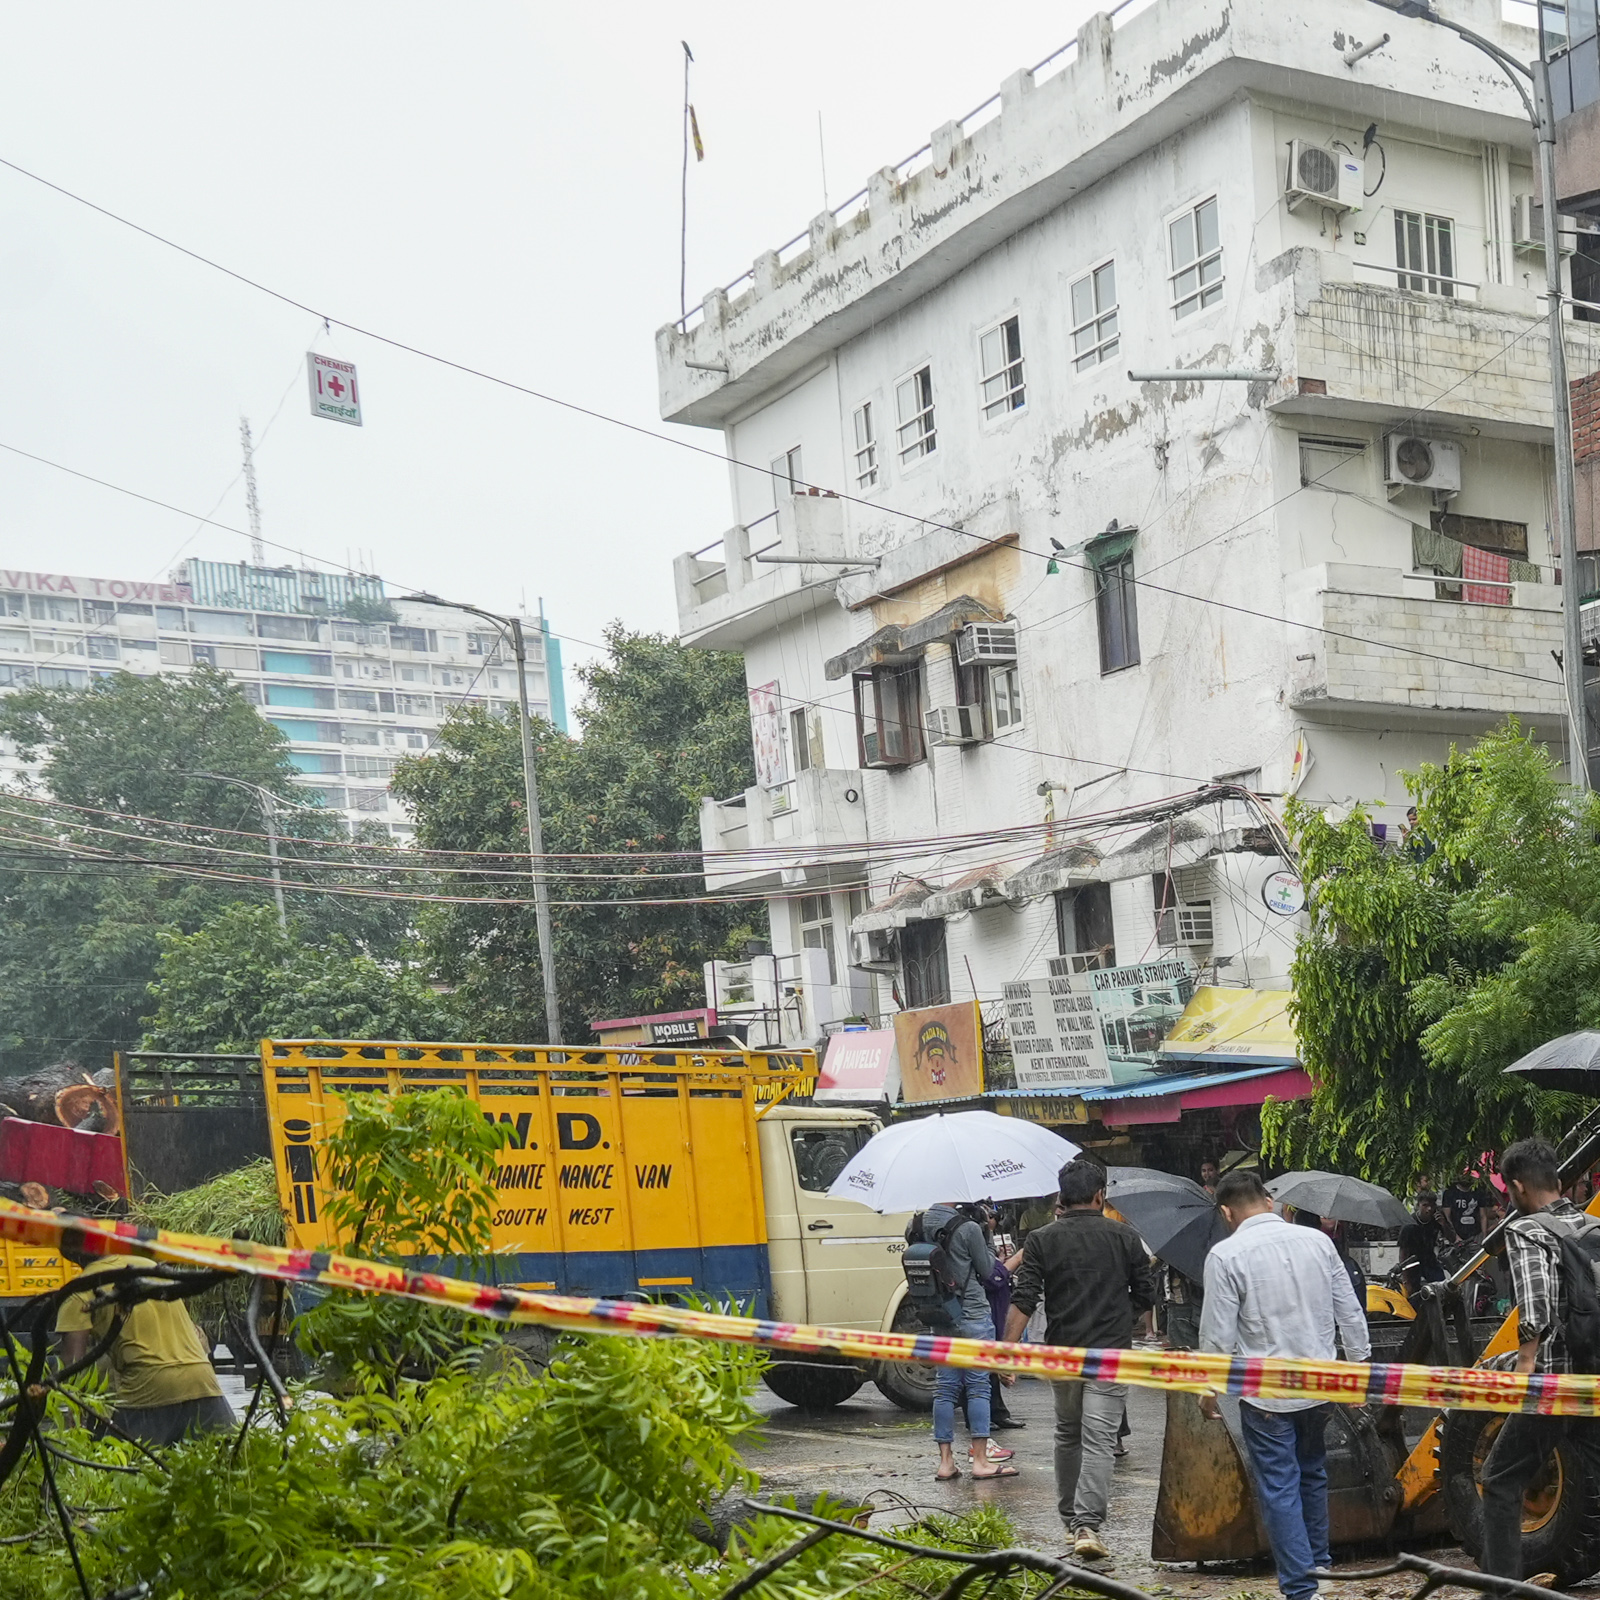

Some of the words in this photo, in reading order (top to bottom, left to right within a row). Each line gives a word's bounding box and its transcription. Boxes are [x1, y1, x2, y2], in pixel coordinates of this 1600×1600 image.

[314, 356, 355, 374] CHEMIST
[1269, 899, 1296, 913] CHEMIST
[1094, 974, 1112, 991] CAR
[1111, 967, 1144, 988] PARKING
[1144, 961, 1187, 983] STRUCTURE
[1004, 982, 1032, 1001] AWNINGS
[1048, 978, 1072, 996] BLINDS
[1007, 1003, 1023, 1018] CARPET
[1023, 1001, 1034, 1016] TILE
[1052, 997, 1078, 1014] ARTIFICIAL
[1076, 995, 1093, 1011] GRASS
[653, 1023, 696, 1037] MOBILE
[1010, 1021, 1023, 1036] WALL
[1022, 1020, 1037, 1035] PAPER
[1056, 1018, 1067, 1033] PVC
[1067, 1016, 1080, 1032] WALL
[1079, 1015, 1095, 1031] PANEL
[1013, 1039, 1033, 1055] WOODEN
[1032, 1038, 1054, 1053] FLOORING
[1060, 1037, 1071, 1051] PVC
[1070, 1035, 1094, 1050] FLOORING
[842, 1049, 882, 1070] HAVELLS
[1030, 1057, 1045, 1070] KENT
[1045, 1055, 1090, 1069] INTERNATIONAL
[1009, 1101, 1040, 1121] WALL
[1041, 1100, 1078, 1120] PAPER
[556, 1112, 611, 1151] D.
[858, 1169, 875, 1181] TIMES
[980, 1163, 1027, 1181] NETWORK
[985, 1158, 1014, 1172] TIMES
[558, 1163, 615, 1190] NANCE
[634, 1163, 673, 1190] VAN
[847, 1175, 876, 1189] NETWORK
[1455, 1199, 1467, 1209] 76
[492, 1207, 548, 1227] SOUTH
[568, 1207, 615, 1226] WEST
[974, 1352, 1031, 1370] NOT
[1043, 1356, 1083, 1374] DO
[1279, 1370, 1359, 1392] DELHI
[1429, 1369, 1516, 1389] CROSS
